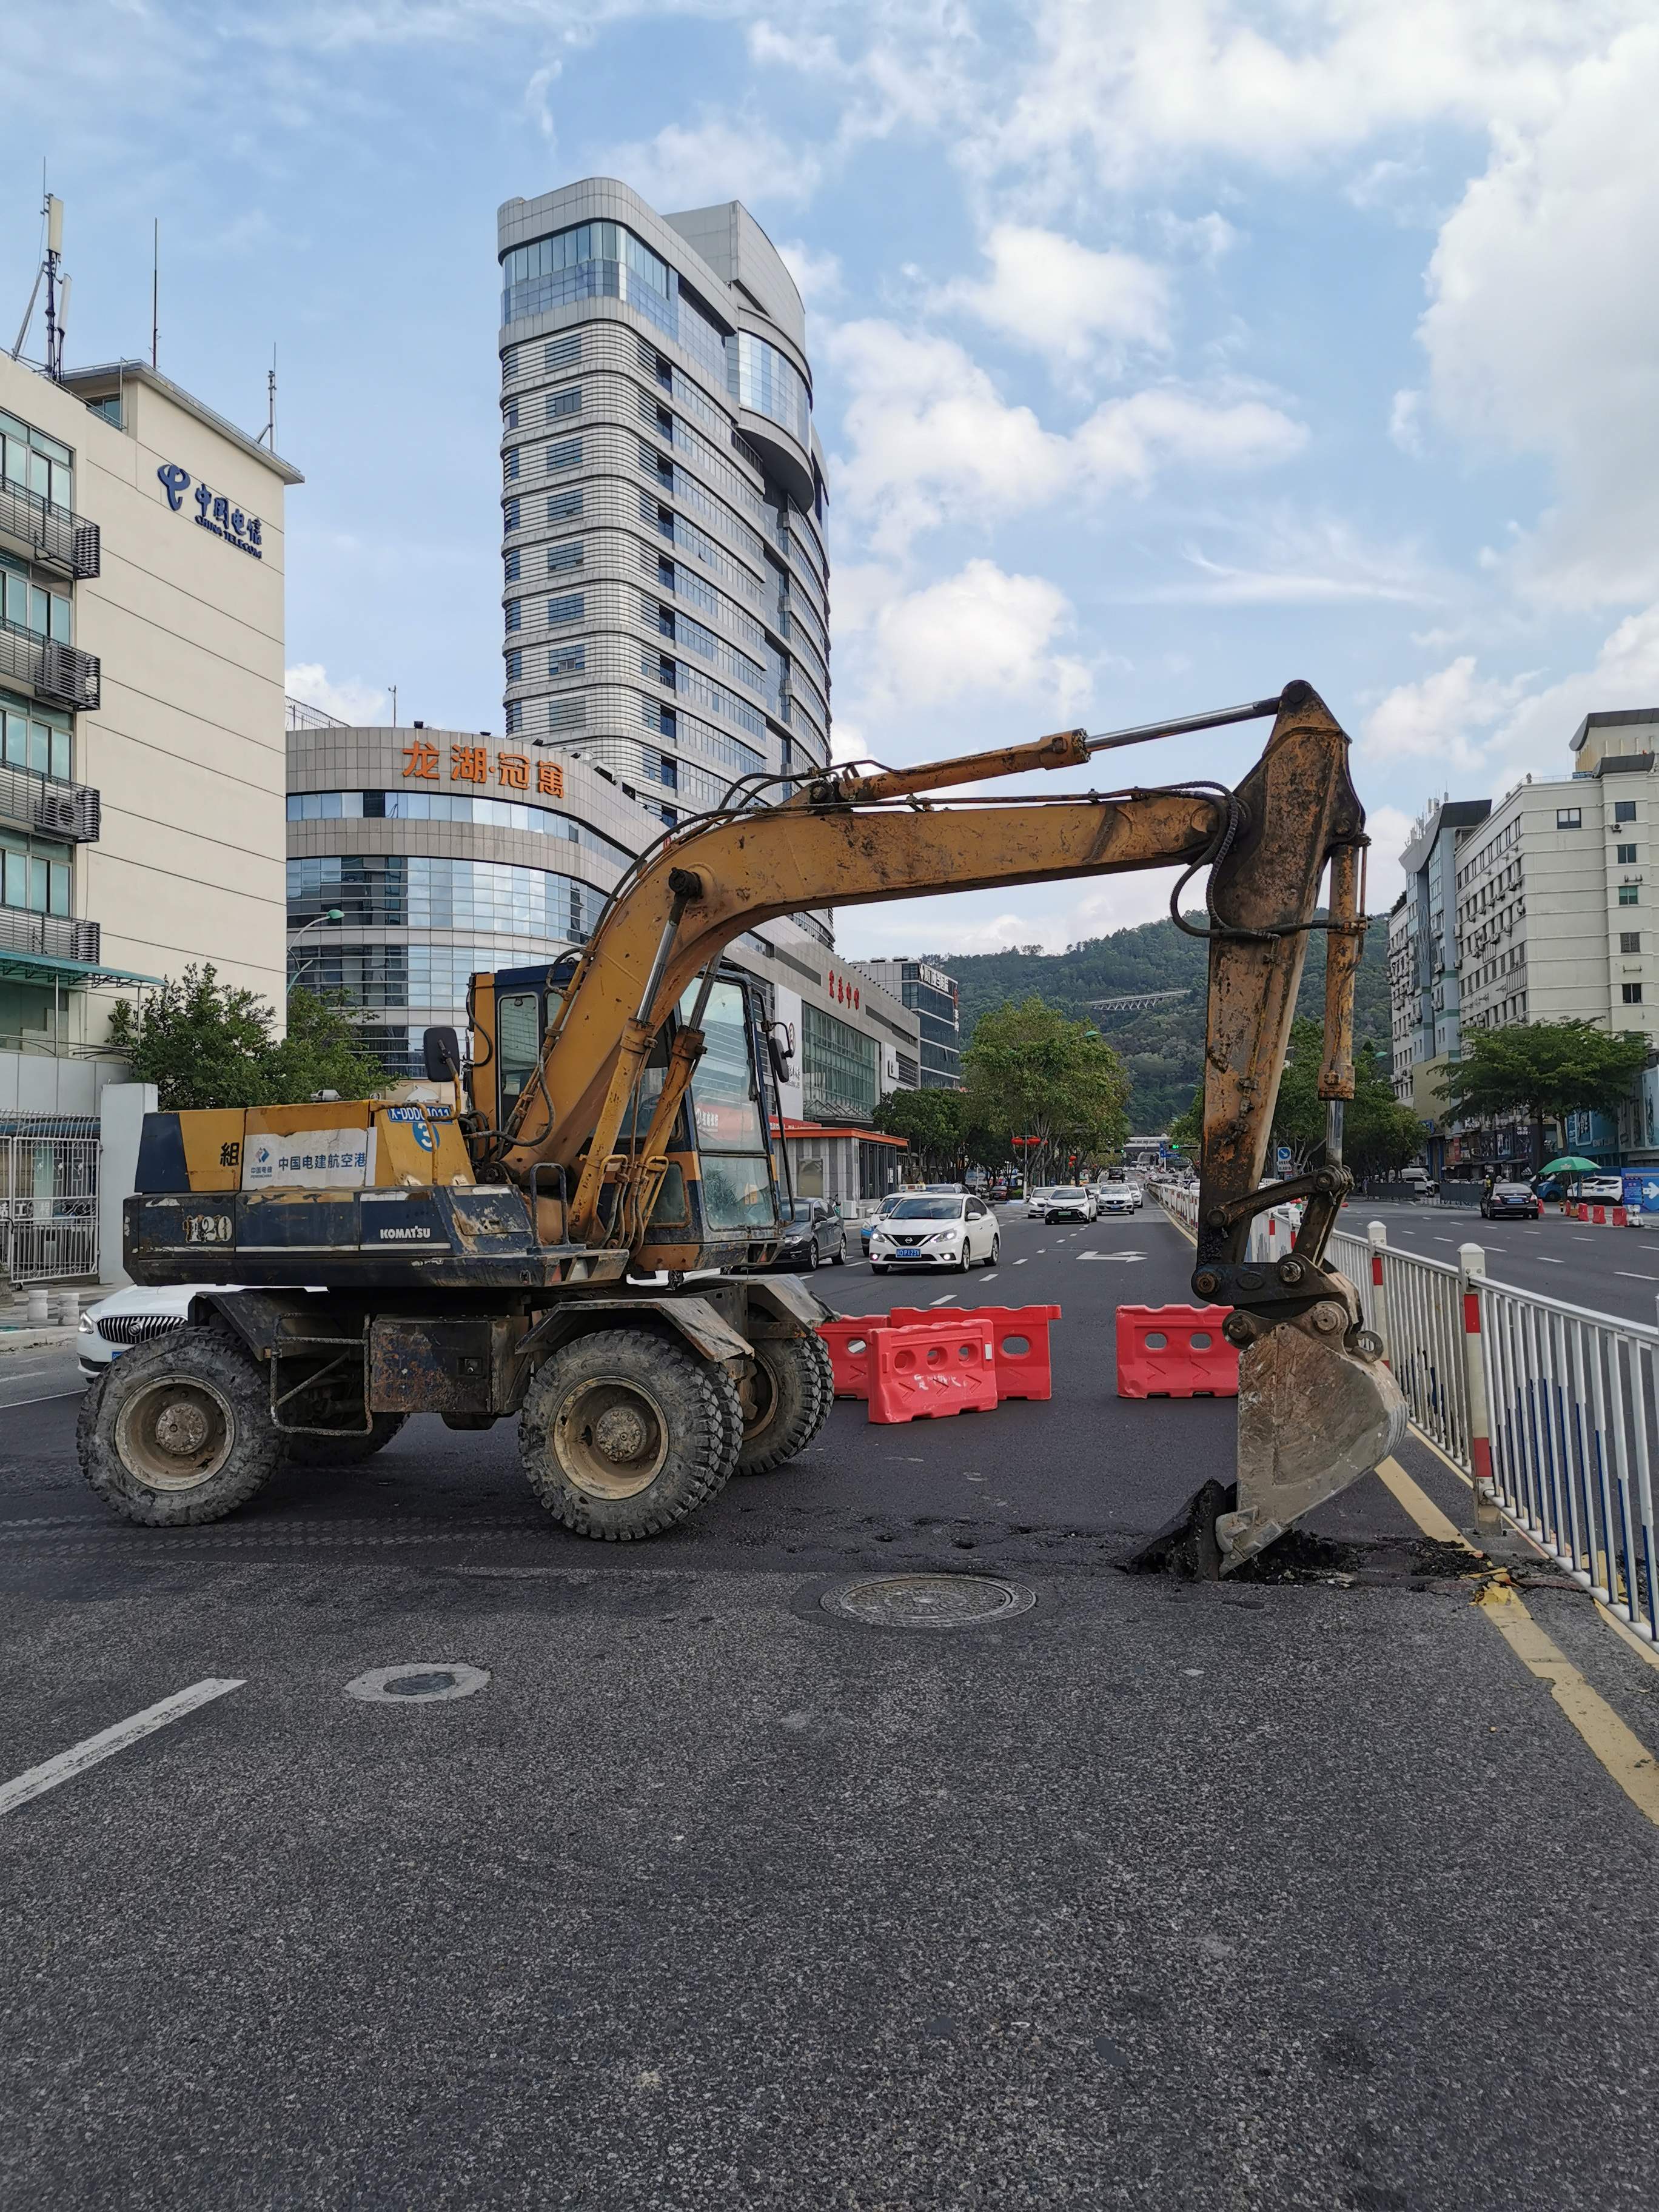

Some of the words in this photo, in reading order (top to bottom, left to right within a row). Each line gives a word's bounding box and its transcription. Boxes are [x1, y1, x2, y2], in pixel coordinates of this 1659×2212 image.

[194, 483, 263, 546] 中国电信
[223, 530, 262, 560] TELECOM
[418, 1123, 433, 1148] 3
[278, 1153, 367, 1171] 中国电建航空港
[380, 1225, 431, 1239] KOMATSU
